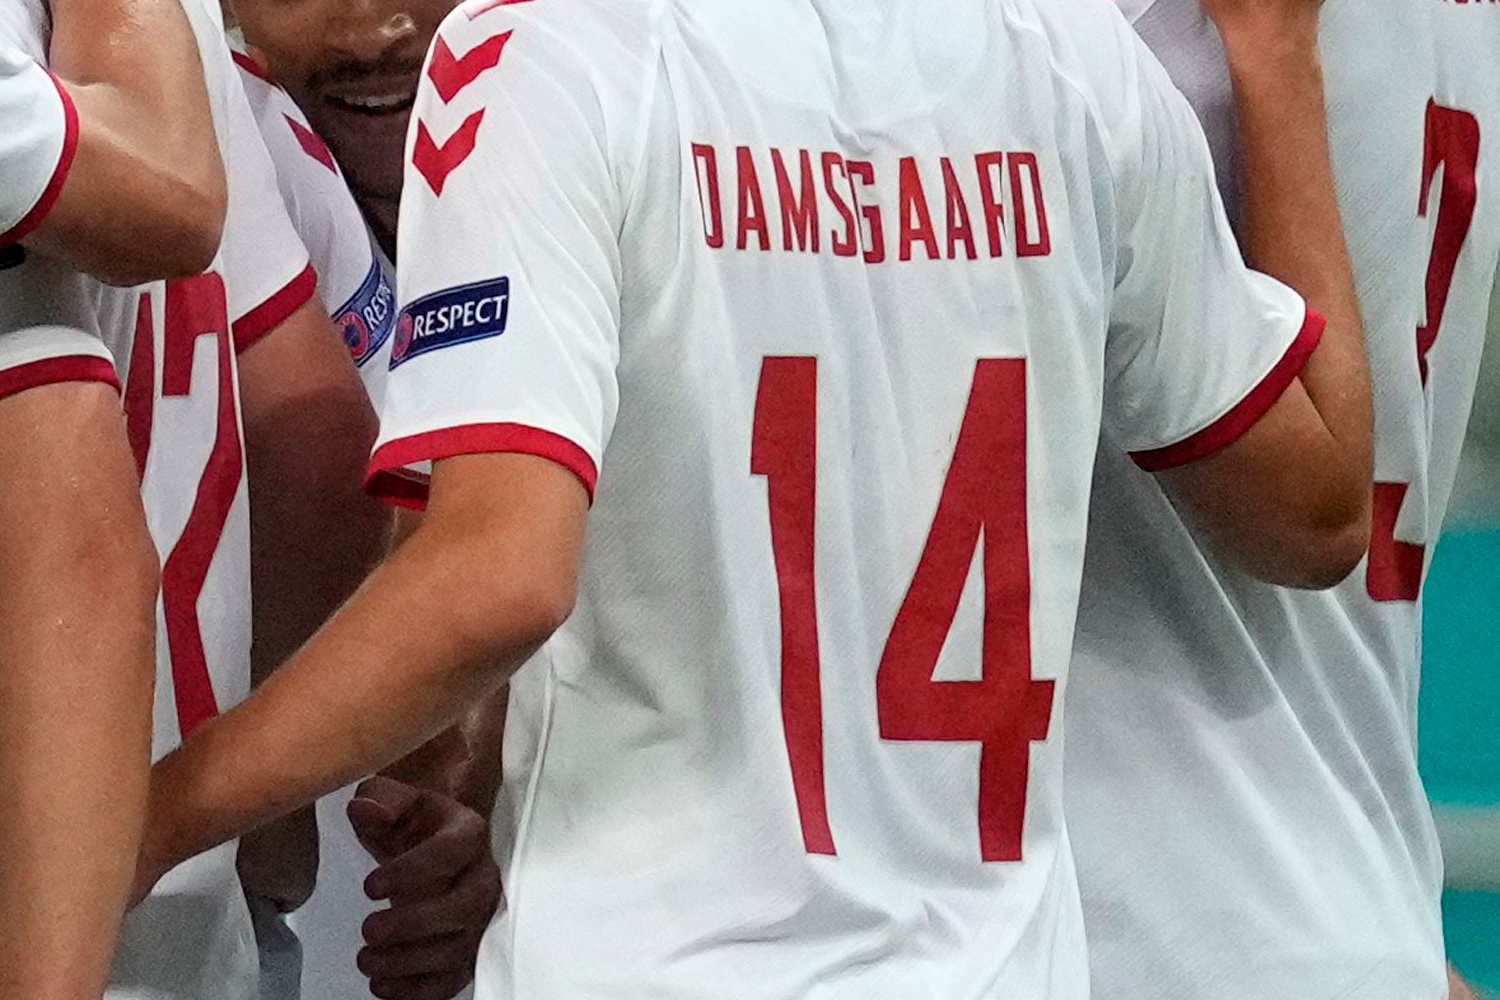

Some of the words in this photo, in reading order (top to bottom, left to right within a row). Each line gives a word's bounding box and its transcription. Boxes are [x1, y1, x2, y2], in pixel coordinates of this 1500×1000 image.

[691, 141, 1051, 263] DAMSGAARD
[412, 294, 508, 341] RESPECT
[750, 355, 1056, 863] 14
